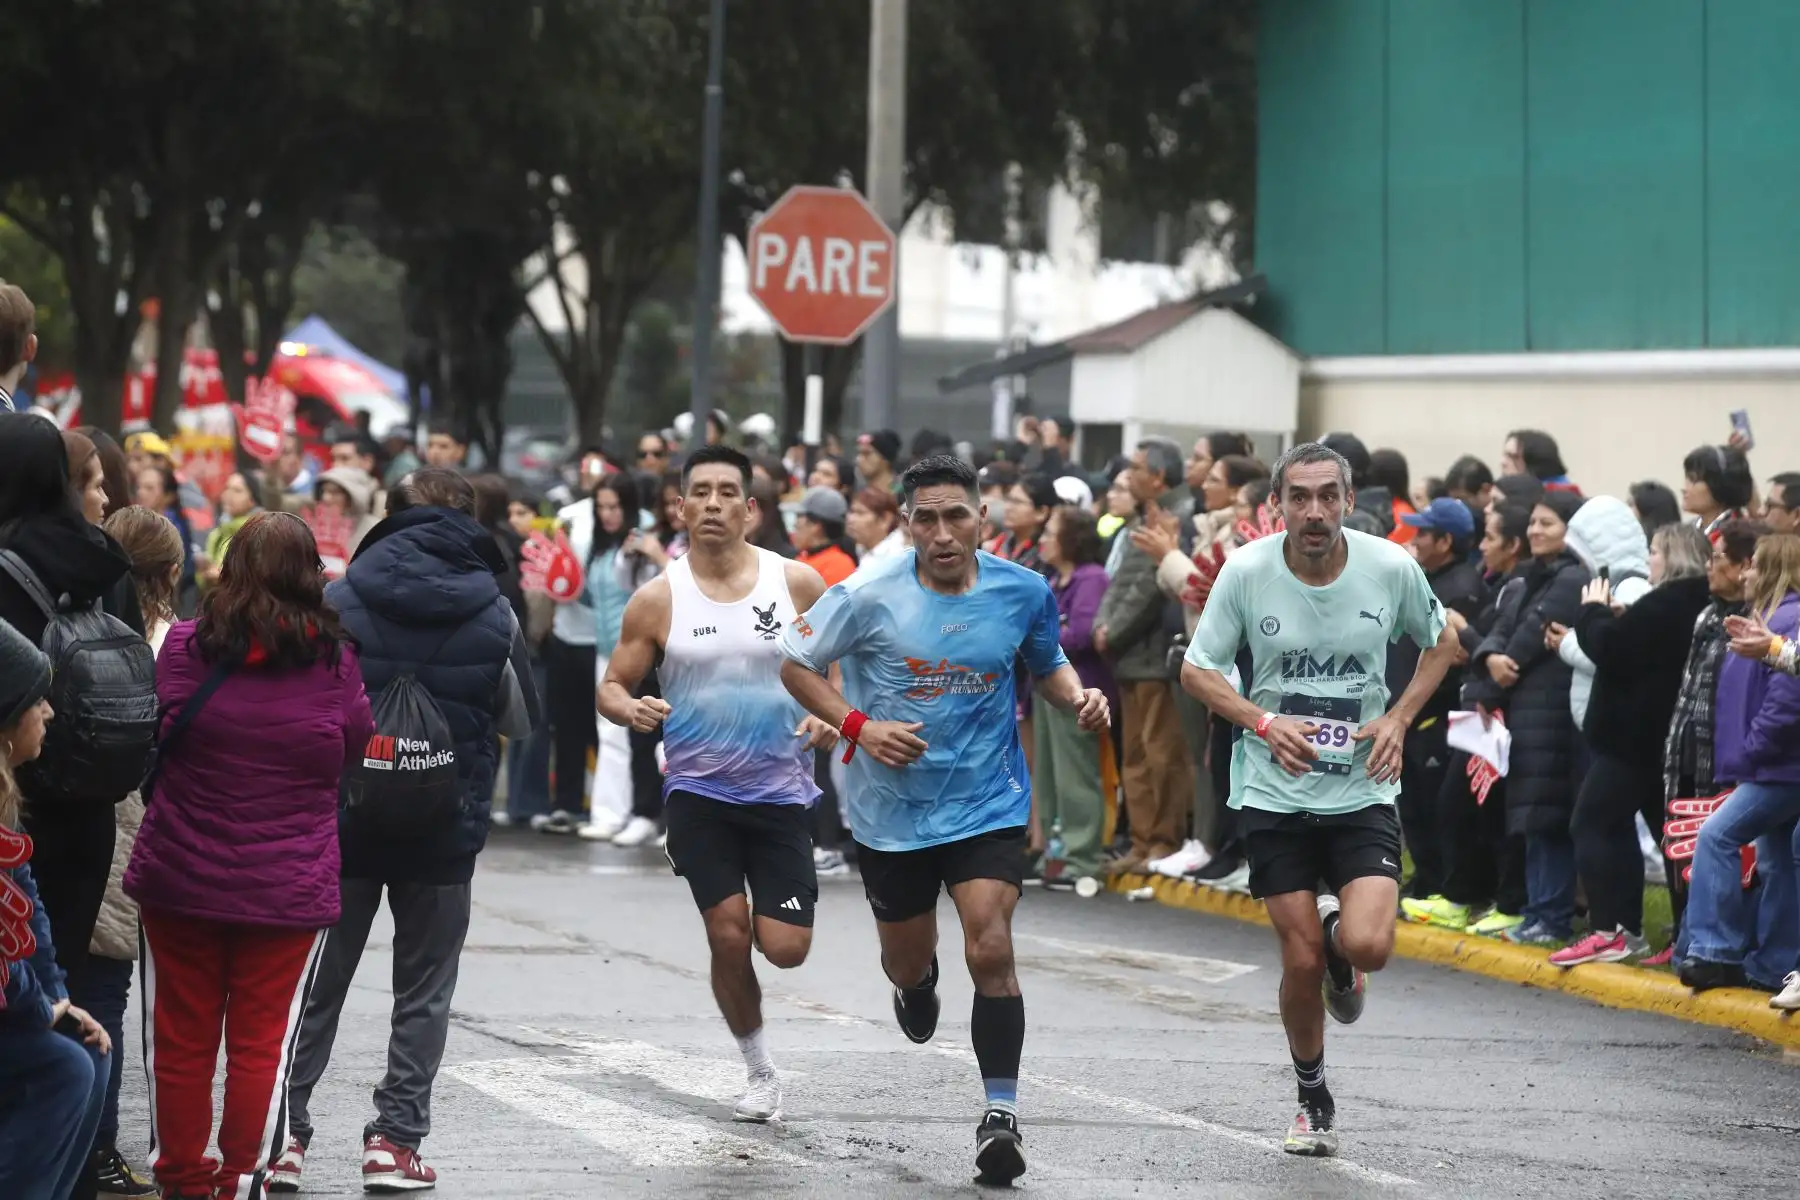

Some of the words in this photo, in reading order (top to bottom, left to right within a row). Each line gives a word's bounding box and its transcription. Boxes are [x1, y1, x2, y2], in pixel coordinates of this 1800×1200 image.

[756, 233, 888, 296] PARE
[693, 626, 717, 637] SUB4
[950, 683, 995, 695] RUNNING
[398, 738, 430, 752] New
[398, 750, 455, 771] Athletic
